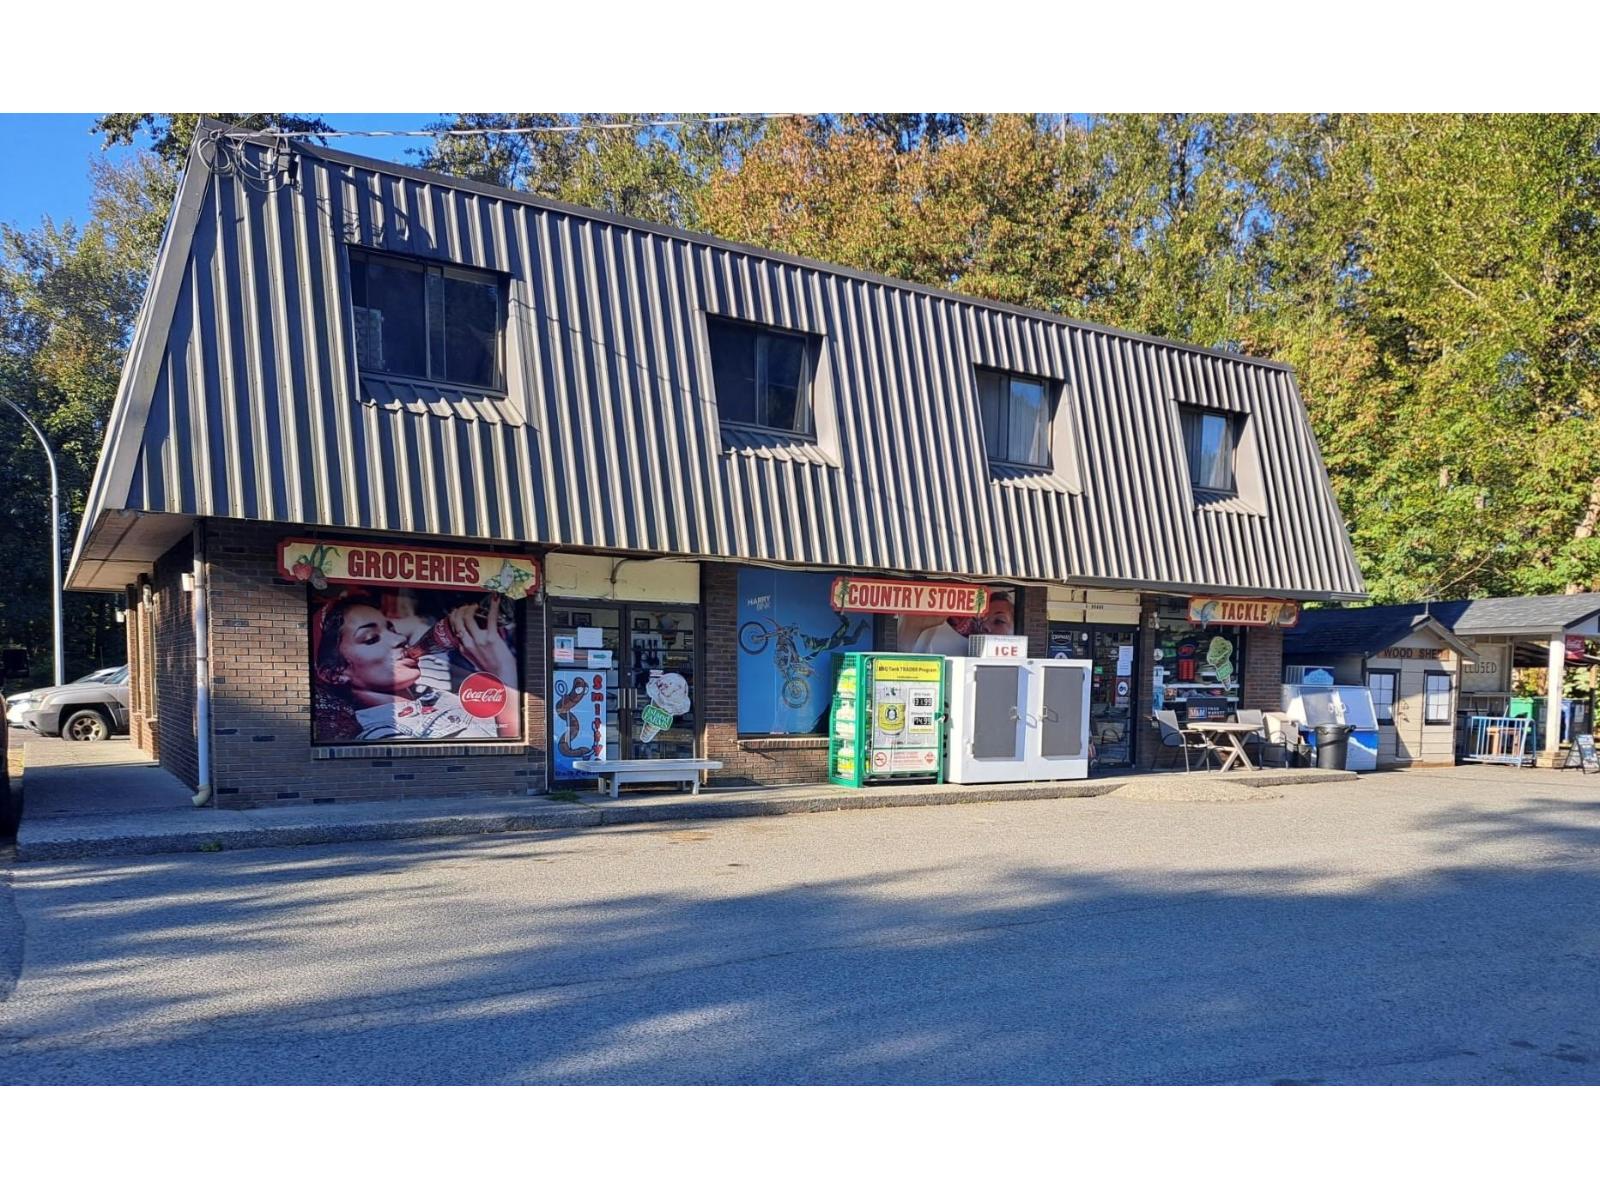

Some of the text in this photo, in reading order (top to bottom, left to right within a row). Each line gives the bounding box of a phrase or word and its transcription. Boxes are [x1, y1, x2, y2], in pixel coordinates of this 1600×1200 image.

[348, 550, 480, 584] GROCERIES
[849, 584, 976, 611] COUNTRY STORE
[1221, 602, 1267, 621] TACKLE
[995, 646, 1018, 657] ICE
[1384, 648, 1413, 658] WOOD
[461, 688, 505, 703] Coca-Cola
